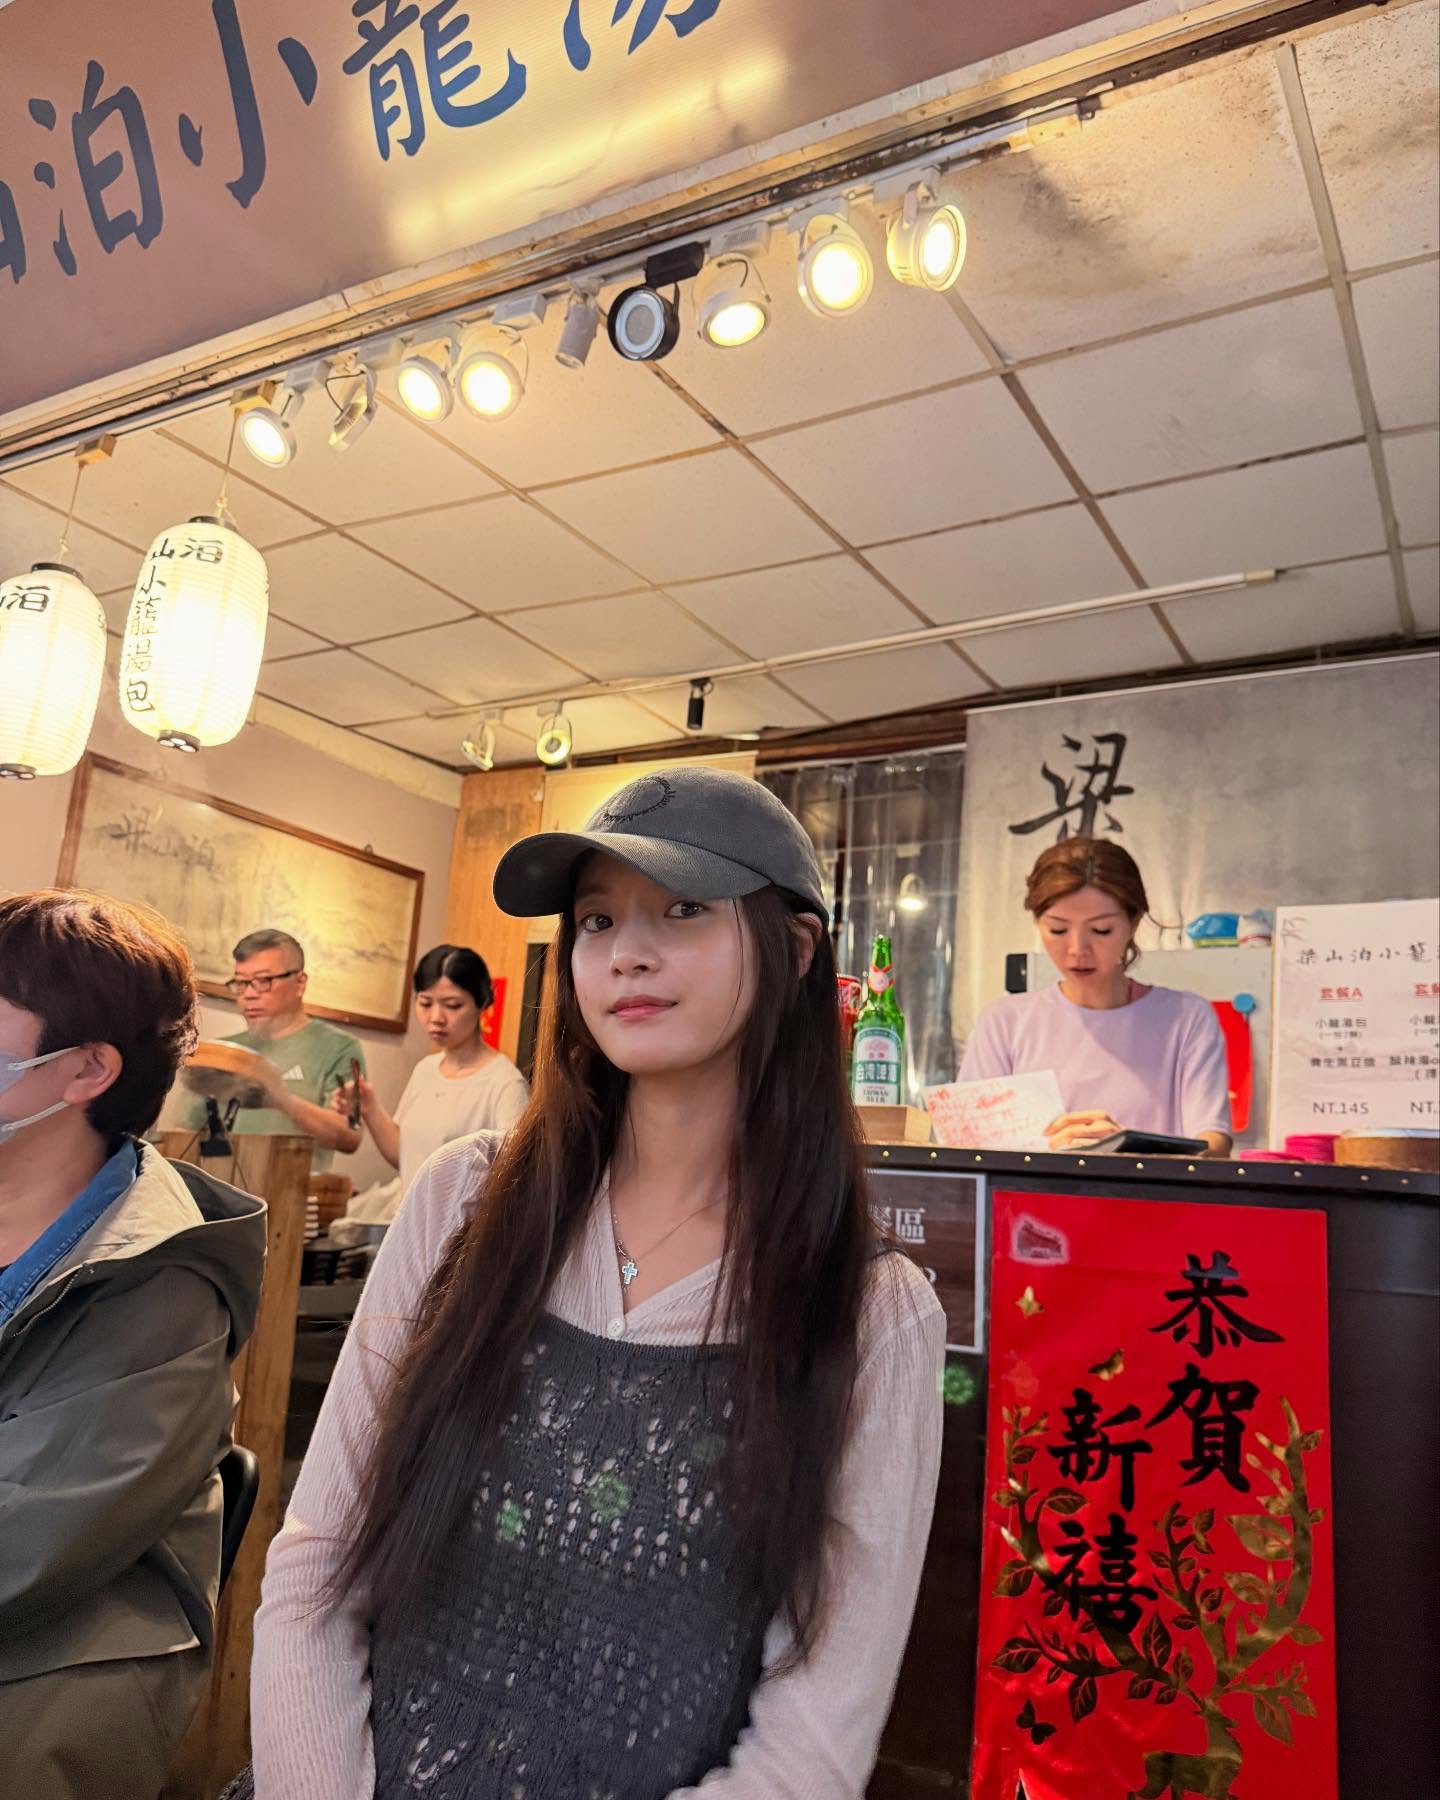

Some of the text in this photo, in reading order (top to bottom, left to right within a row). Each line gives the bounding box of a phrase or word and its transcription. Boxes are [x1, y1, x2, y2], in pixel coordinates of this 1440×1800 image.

[0, 585, 50, 612] 泊
[1008, 733, 1134, 841] 梁
[1312, 1102, 1369, 1115] NT.145
[1144, 1250, 1286, 1494] 恭賀
[1044, 1386, 1160, 1635] 新禧
